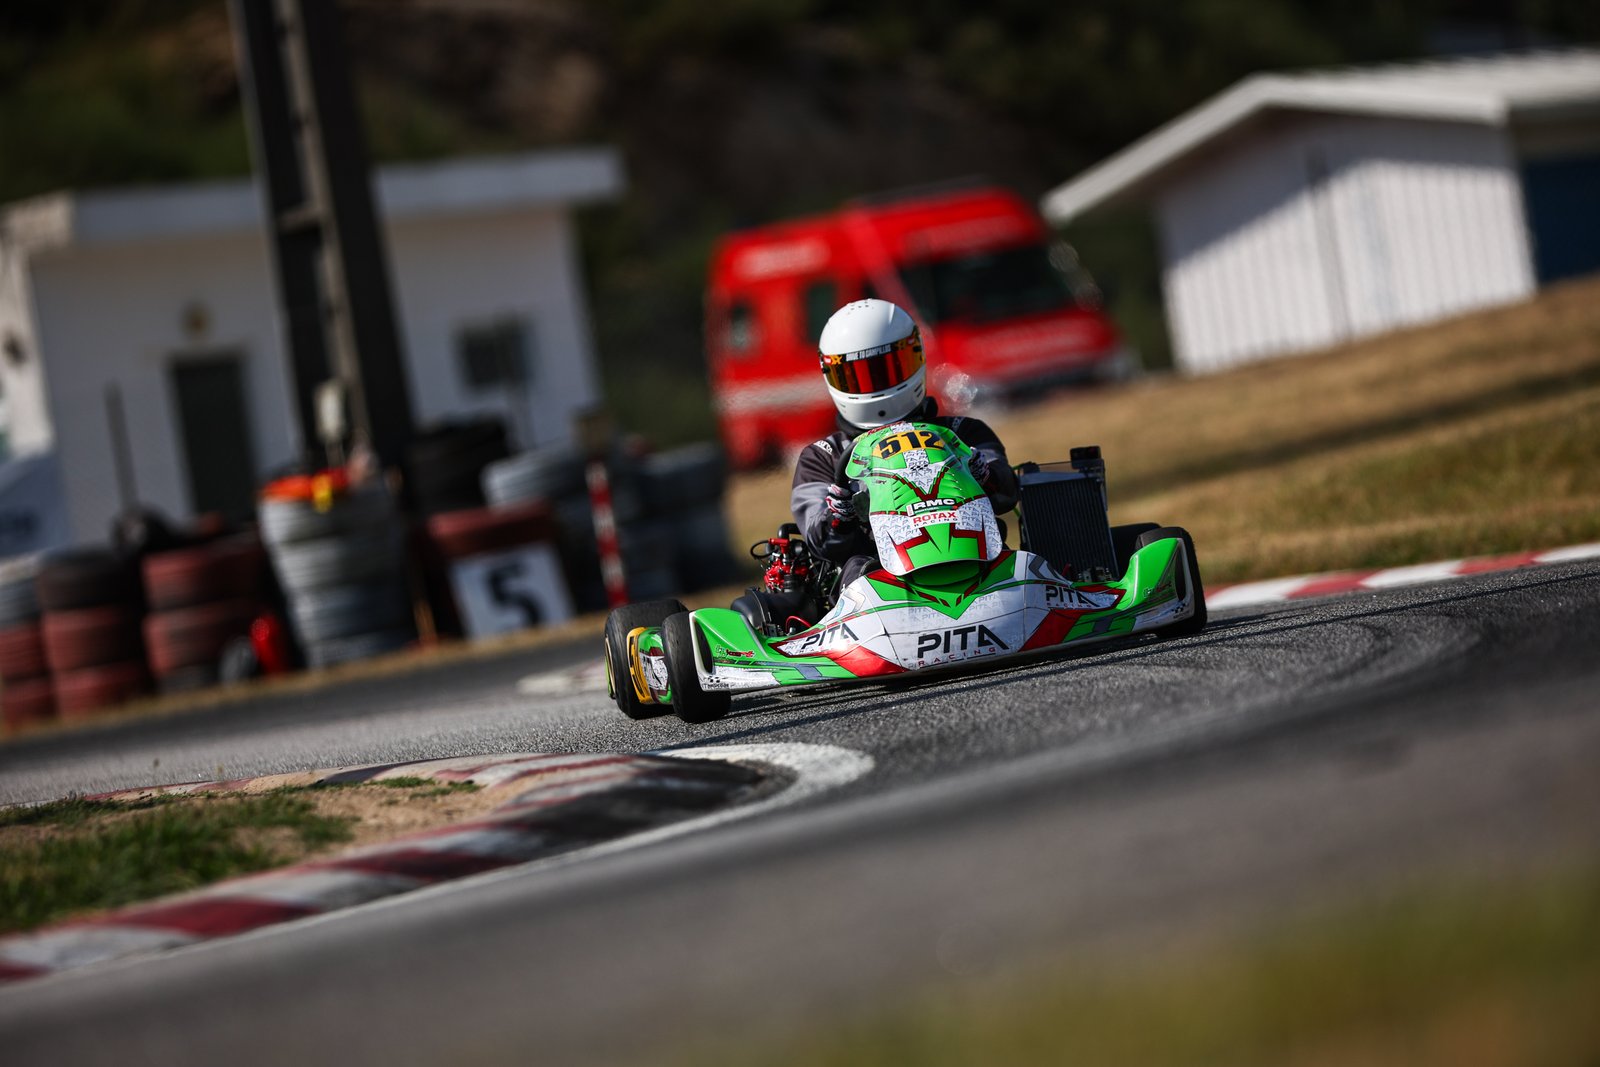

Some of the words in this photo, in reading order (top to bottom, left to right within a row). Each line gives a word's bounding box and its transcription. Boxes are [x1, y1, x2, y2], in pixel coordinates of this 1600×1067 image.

[879, 431, 946, 459] 512
[913, 499, 955, 510] RMC
[913, 512, 956, 524] ROTAX
[914, 518, 958, 527] RACING
[487, 562, 543, 627] 5
[1046, 585, 1100, 607] PITA
[801, 623, 859, 649] PITA
[917, 624, 1009, 658] PITA
[918, 647, 996, 666] RACING
